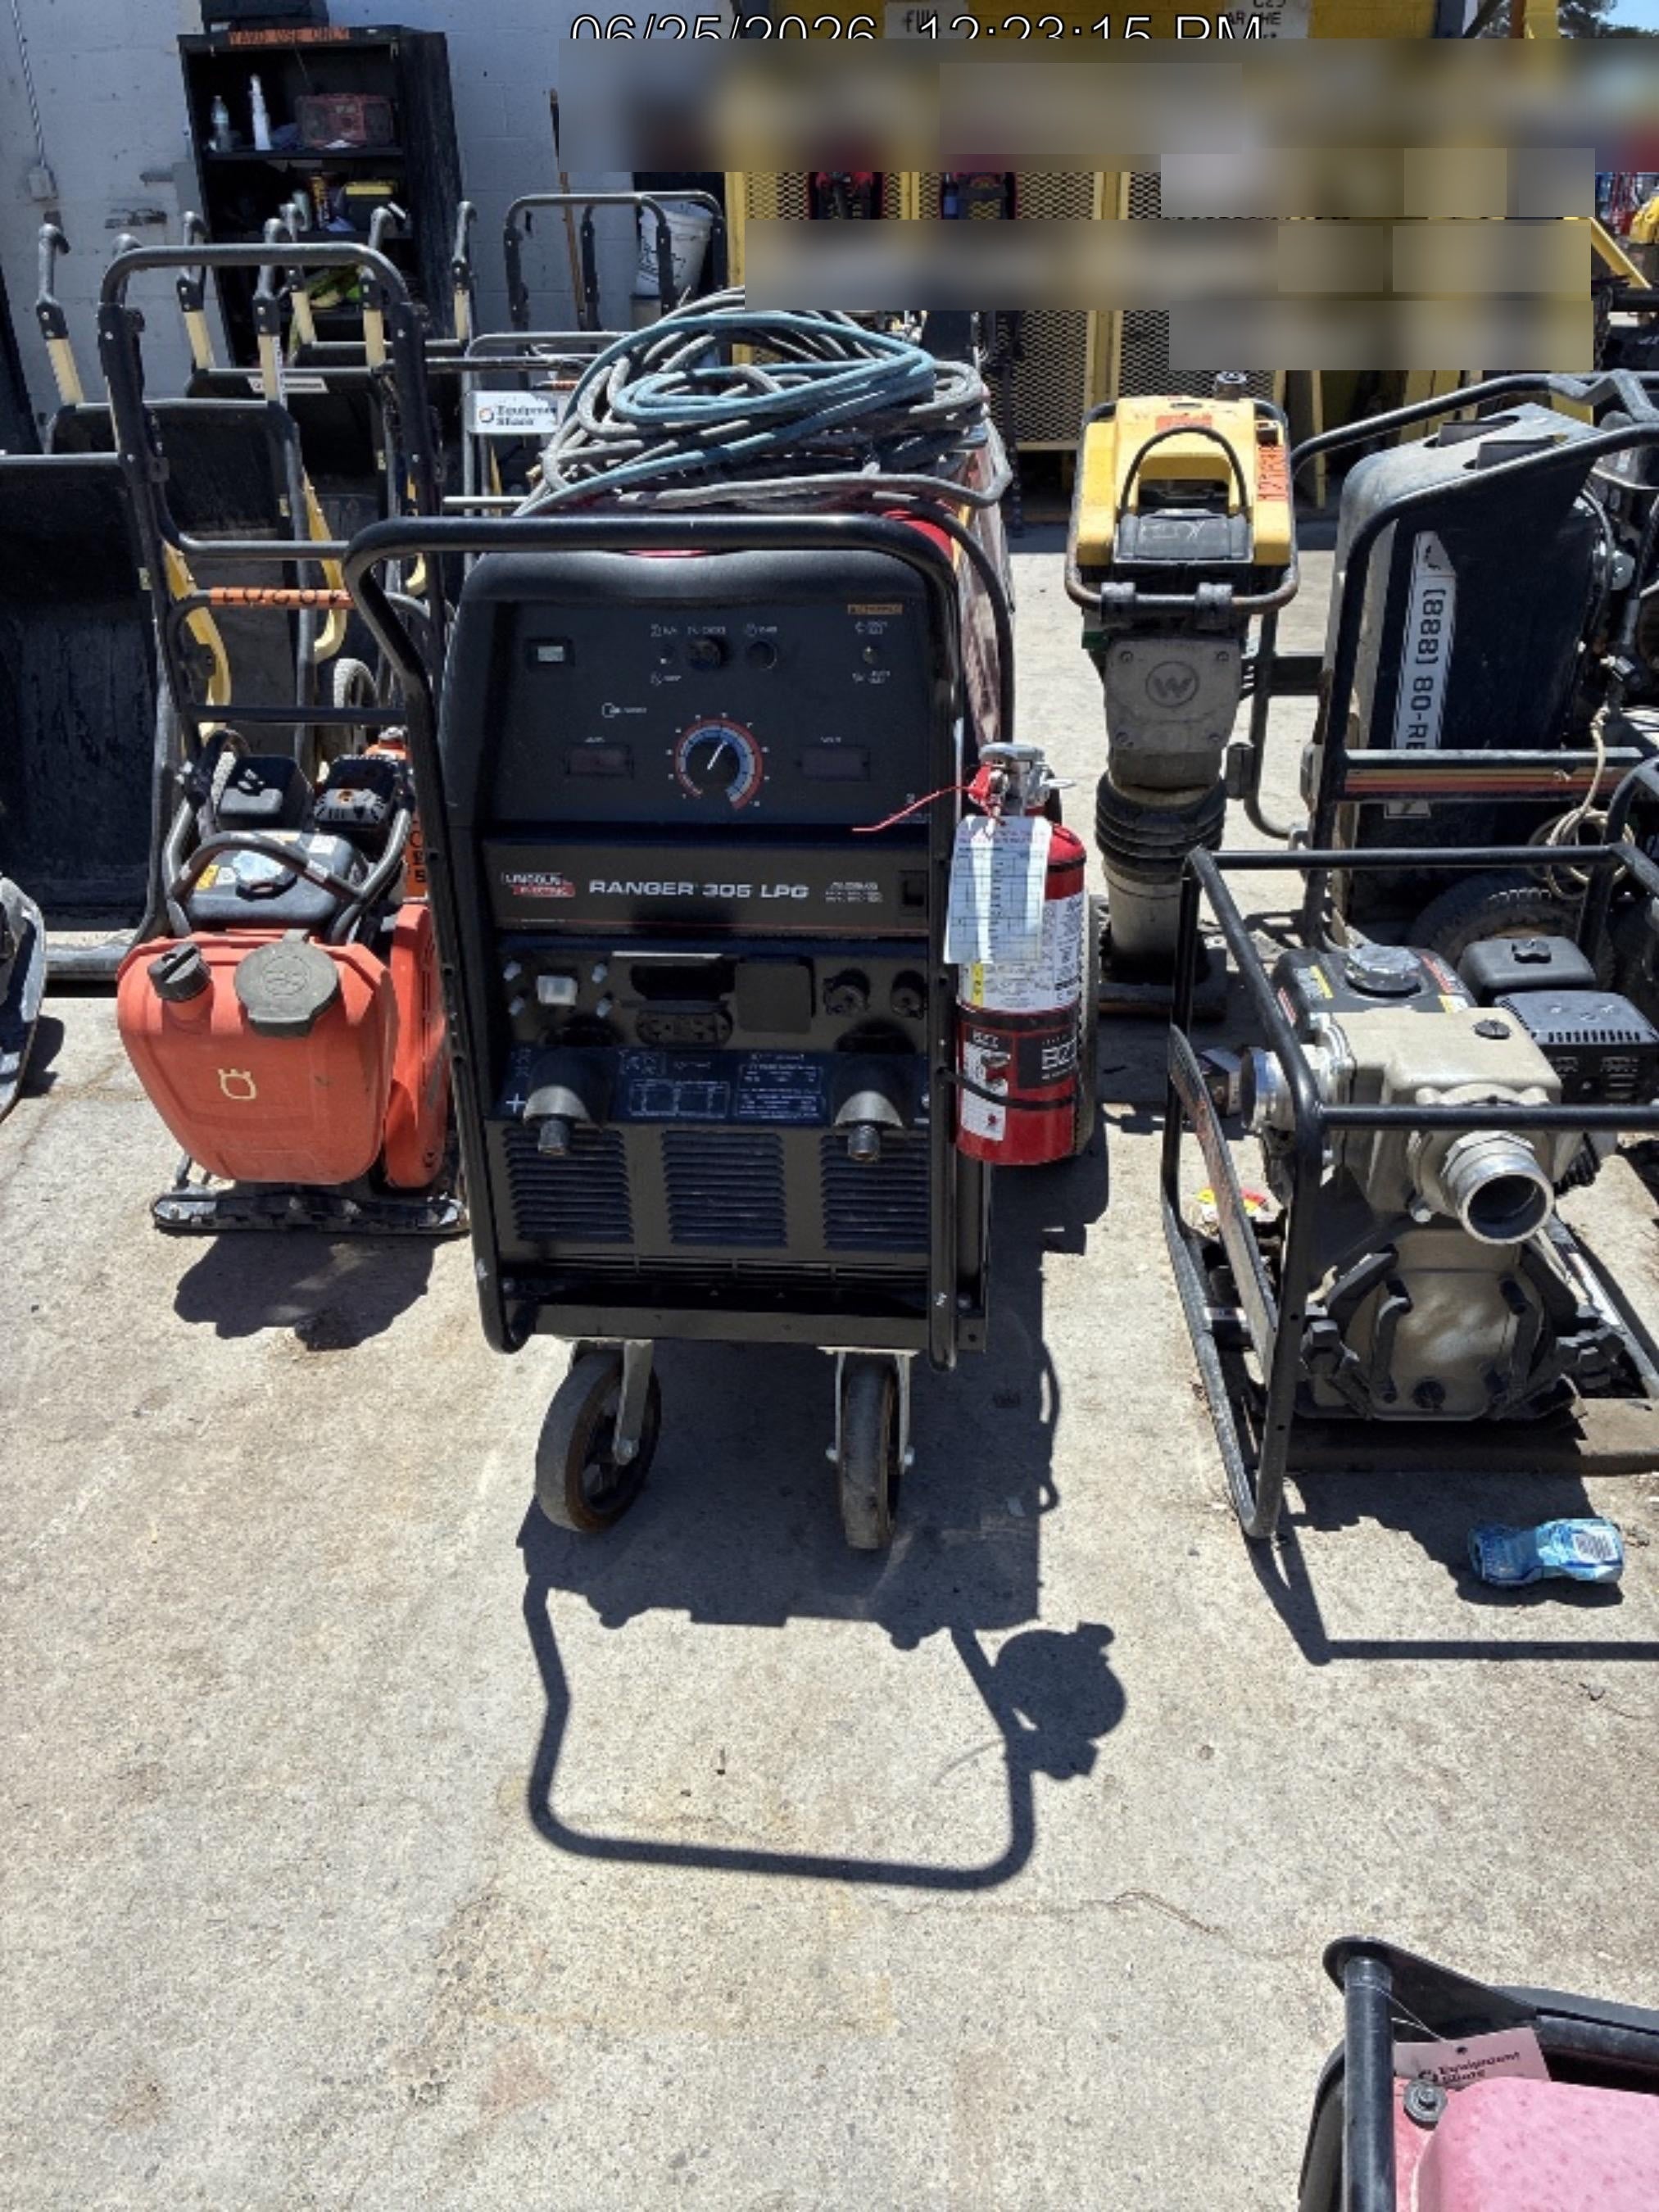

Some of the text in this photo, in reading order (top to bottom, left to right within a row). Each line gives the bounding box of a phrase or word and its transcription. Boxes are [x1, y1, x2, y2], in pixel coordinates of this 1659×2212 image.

[588, 880, 694, 896] RANGER
[702, 883, 752, 898] 305
[759, 884, 809, 899] LPG
